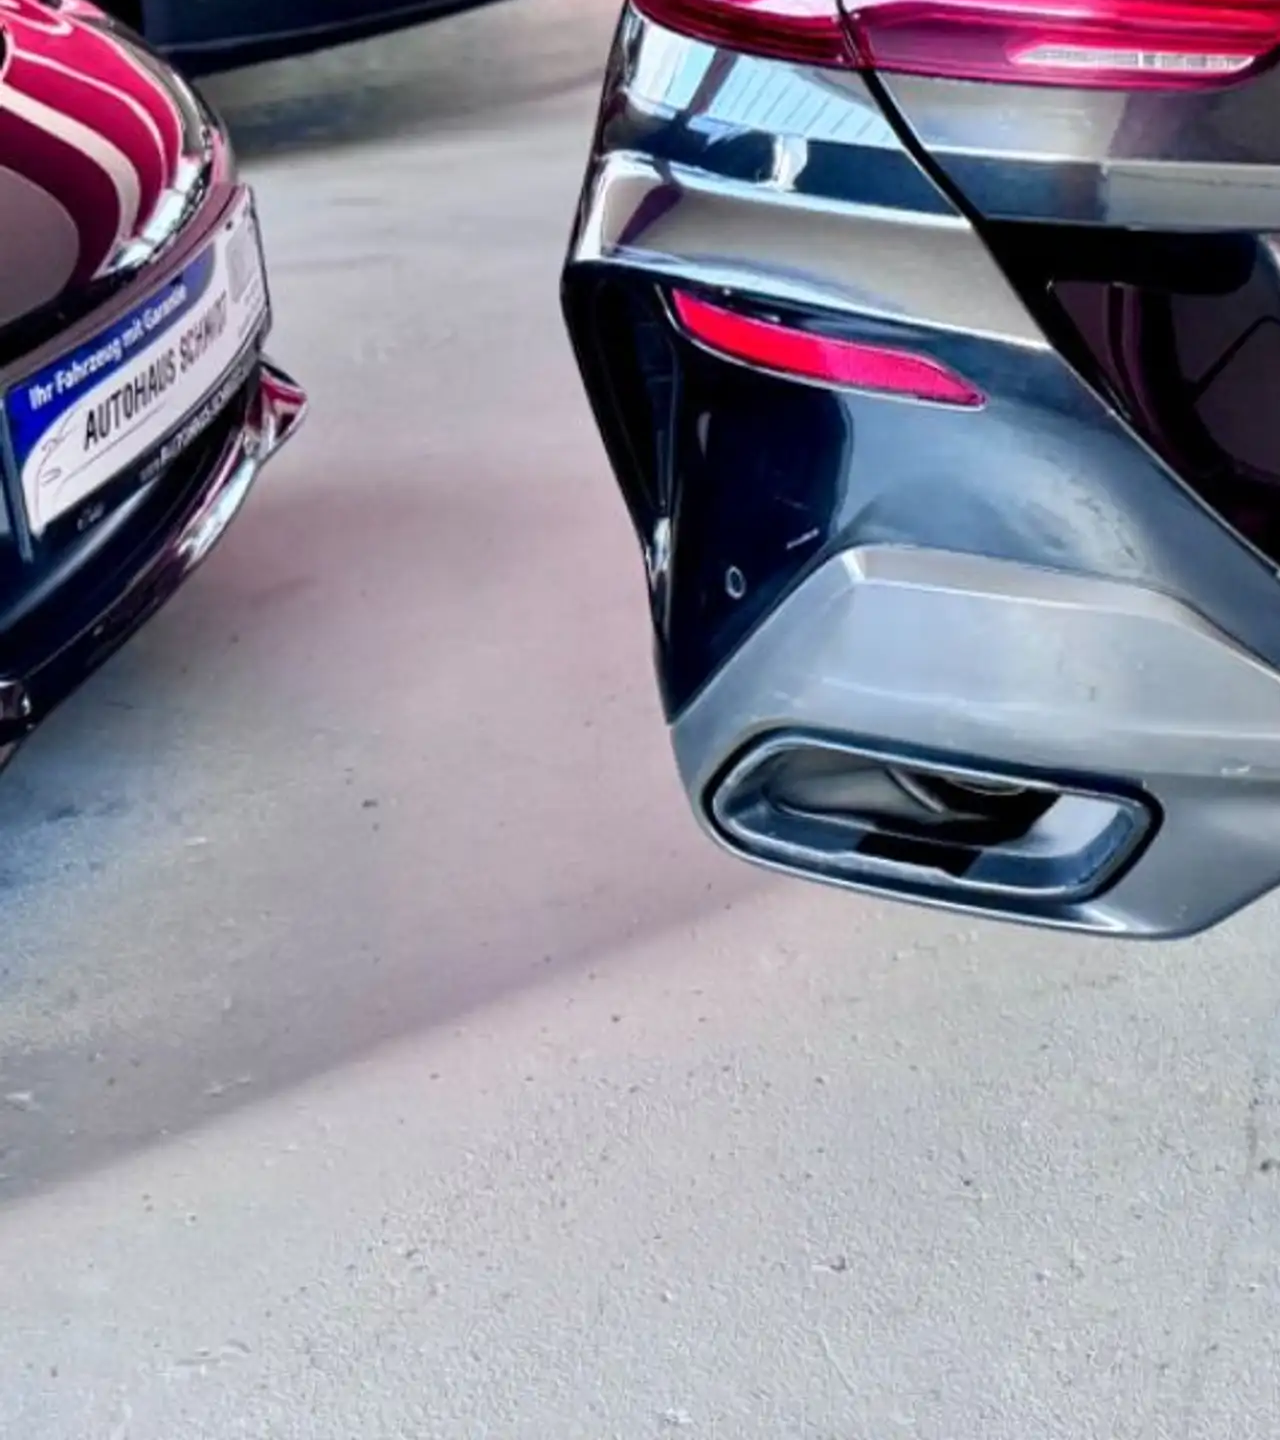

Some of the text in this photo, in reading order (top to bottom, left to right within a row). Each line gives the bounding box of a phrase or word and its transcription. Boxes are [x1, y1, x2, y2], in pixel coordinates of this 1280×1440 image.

[28, 383, 54, 411] Ihr
[54, 337, 123, 395] Fahrzeug
[121, 317, 145, 348] mit
[84, 348, 176, 451] AUTOHAUS
